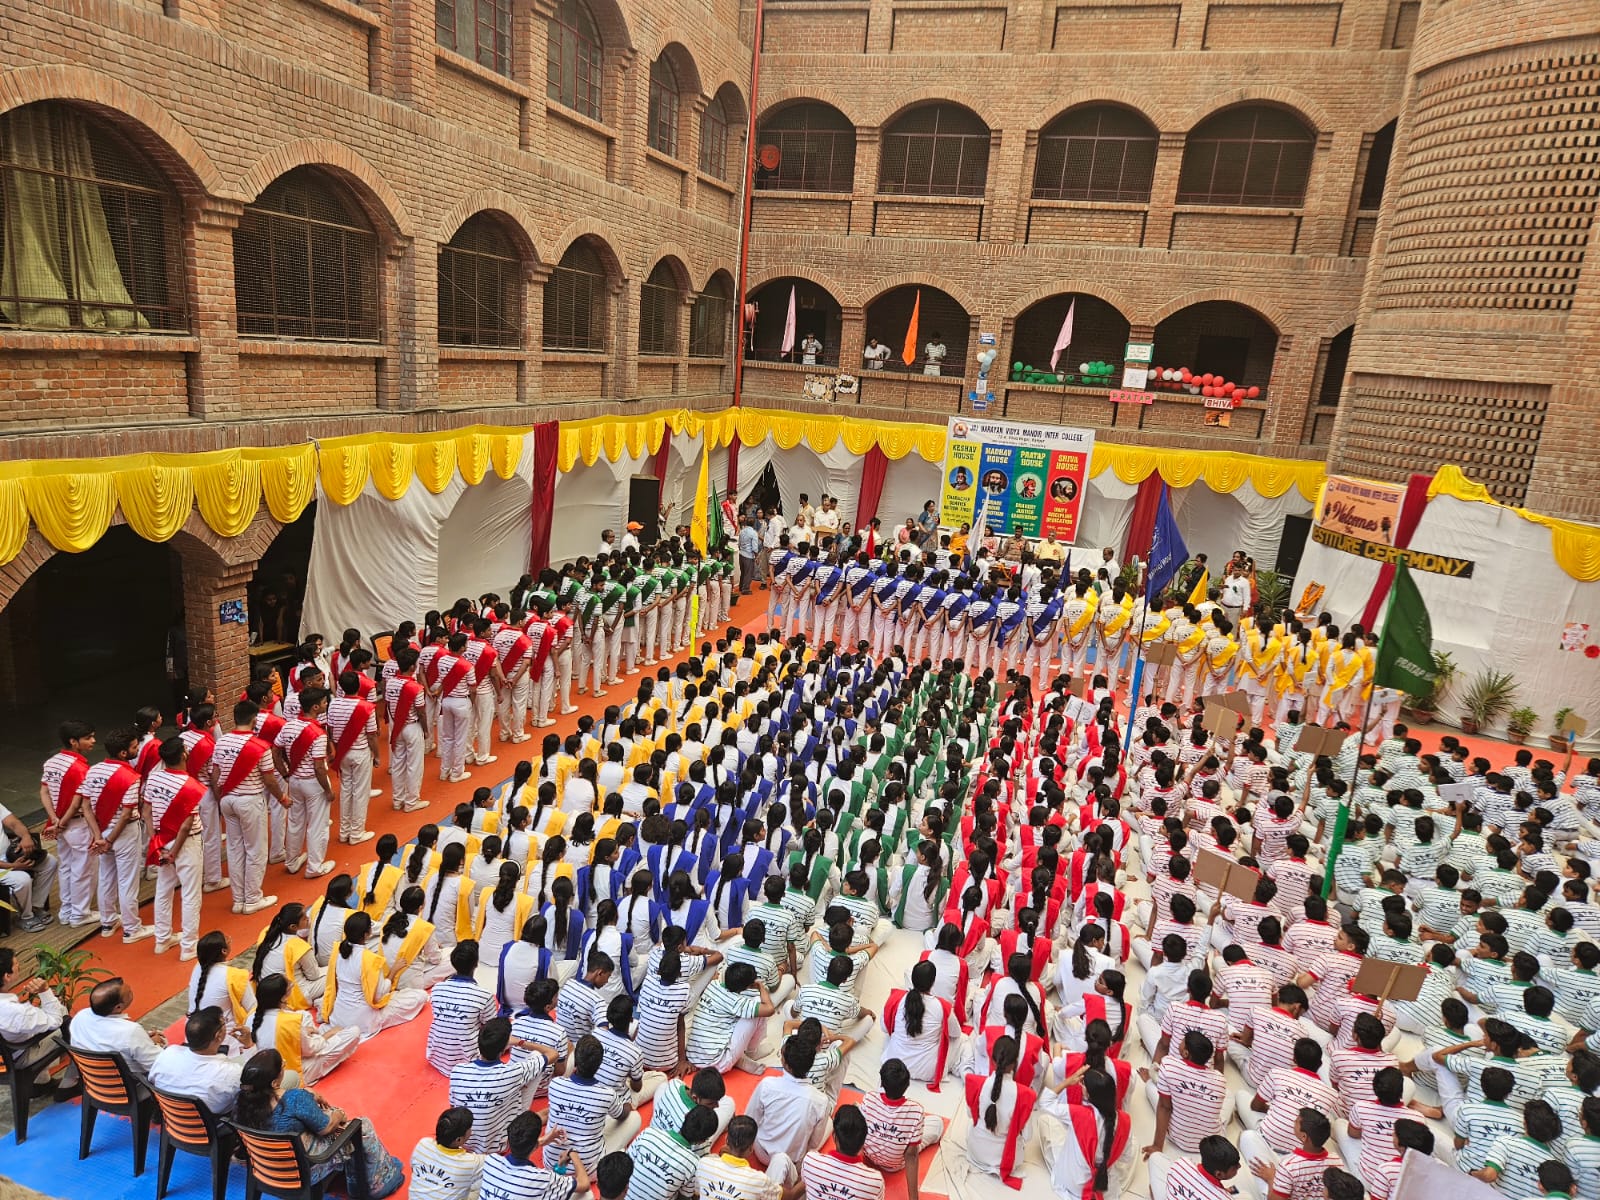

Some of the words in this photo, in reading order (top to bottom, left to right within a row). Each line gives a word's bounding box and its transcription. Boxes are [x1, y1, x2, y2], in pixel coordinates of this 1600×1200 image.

[1112, 393, 1151, 402] PRATAP
[1044, 431, 1059, 440] INTER
[1061, 432, 1084, 442] COLLEGE
[953, 444, 977, 453] KESHAV
[985, 447, 1012, 457] MADHAV
[953, 452, 975, 461] HOUSE
[986, 455, 1009, 464] HOUSE
[1020, 450, 1046, 460] PRATAP
[1058, 454, 1079, 464] SHIVA
[1021, 458, 1044, 468] HOUSE
[1056, 462, 1079, 472] HOUSE
[1364, 542, 1470, 576] CEREMONY
[1483, 1123, 1519, 1138] JNVMI
[415, 1164, 456, 1189] JNVMIC
[703, 1181, 745, 1200] JNVMI
[814, 1182, 857, 1200] JNVMI
